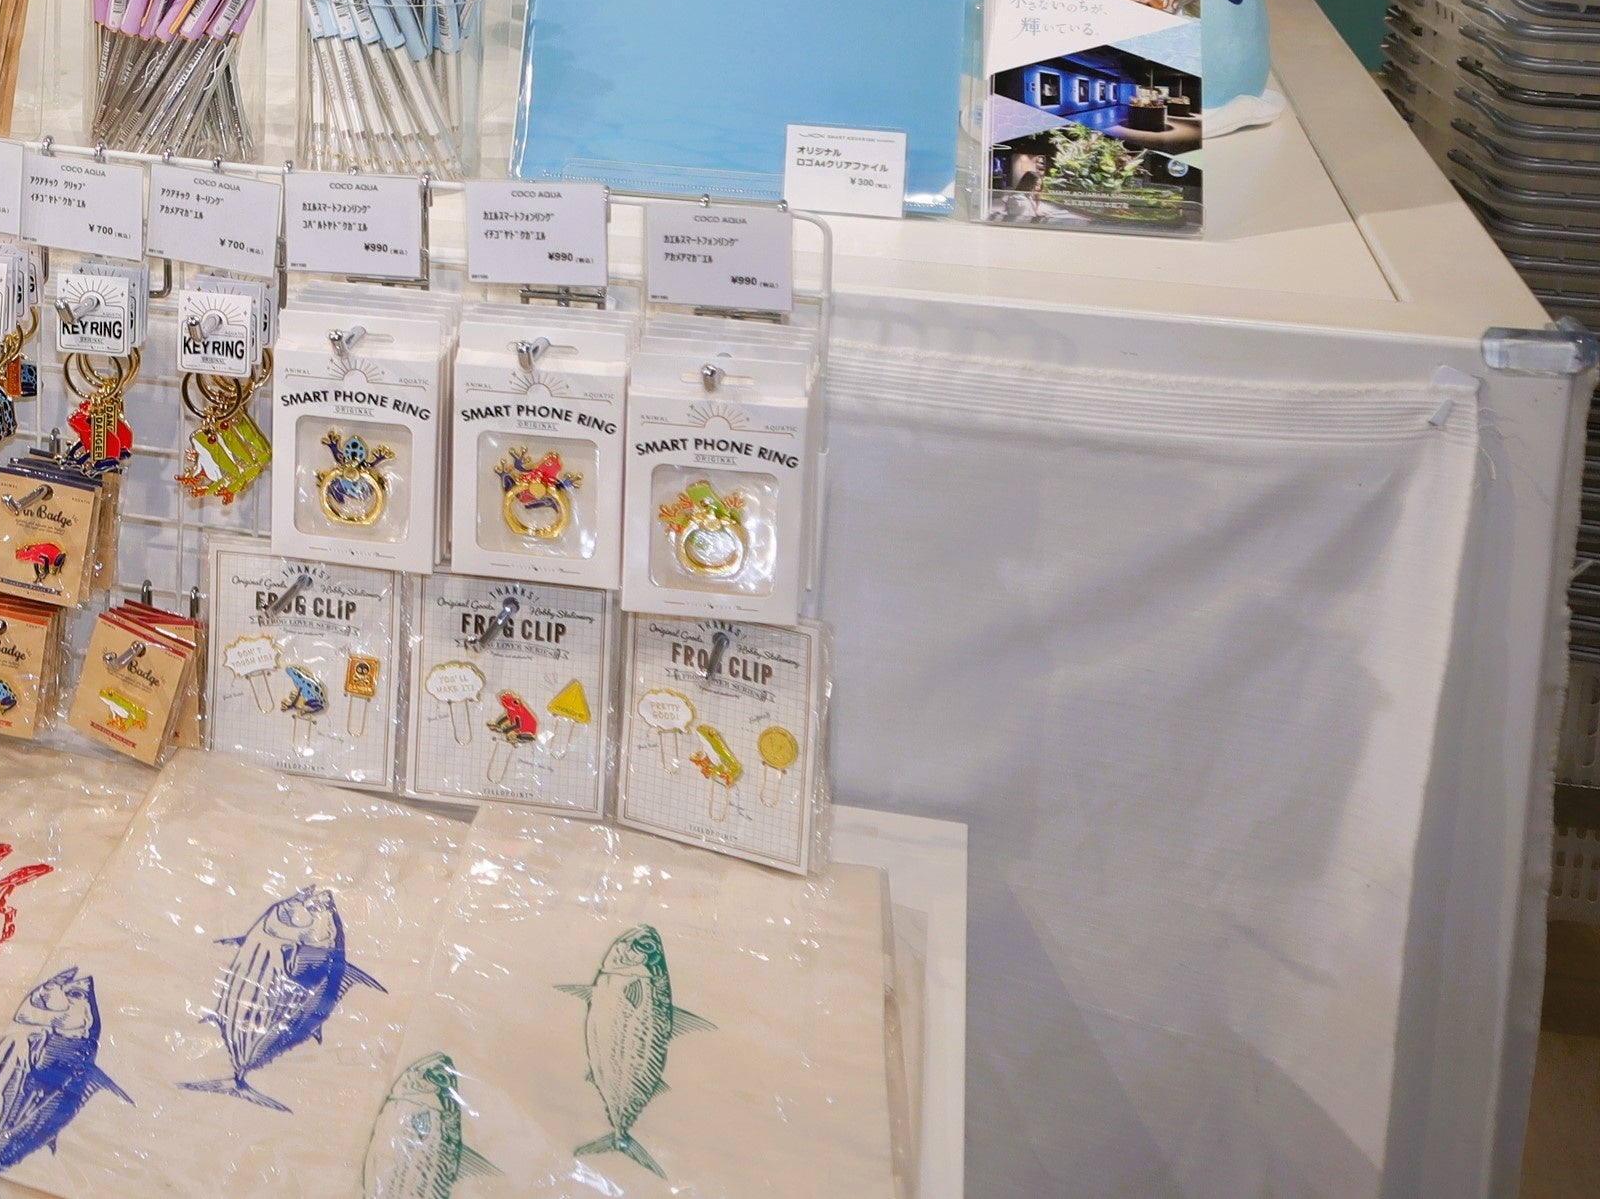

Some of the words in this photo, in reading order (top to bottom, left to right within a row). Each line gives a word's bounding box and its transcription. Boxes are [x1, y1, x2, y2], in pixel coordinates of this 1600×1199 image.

[797, 146, 842, 157] オリジナル
[60, 165, 83, 174] COCO
[84, 168, 106, 177] AQUA
[796, 158, 889, 173] ロゴA4クリアファイル
[193, 177, 217, 188] COCO
[218, 182, 241, 192] AQUA
[329, 182, 353, 190] COCO
[354, 184, 378, 192] AQUA
[849, 177, 874, 187] ¥300
[511, 190, 536, 198] COCO
[538, 191, 563, 199] AQUA
[693, 215, 720, 223] COCO
[88, 223, 113, 235] ¥700
[219, 237, 245, 251] ¥700
[364, 242, 388, 253] ¥990
[547, 251, 574, 262] ¥990
[731, 275, 758, 286] ¥990
[280, 390, 329, 407] SMART
[334, 390, 389, 408] PHONE
[391, 399, 432, 421] RING
[335, 406, 374, 416] ORIGINAL
[460, 404, 512, 422] SMART
[516, 404, 574, 422] PHONE
[577, 413, 618, 435] RING
[517, 420, 557, 430] ORIGINAL
[95, 415, 103, 459] DANGER
[635, 438, 688, 456] SMART
[693, 438, 754, 457] PHONE
[757, 446, 799, 469] RING
[695, 454, 737, 464] ORIGINAL
[36, 504, 73, 527] Badge
[231, 575, 263, 588] Original
[437, 596, 469, 609] Original
[312, 597, 358, 621] CLIP
[520, 619, 567, 644] CLIP
[649, 623, 680, 639] Original
[126, 659, 161, 687] Badge
[729, 656, 774, 685] CLIP
[650, 701, 680, 711] PRETTY
[652, 711, 680, 721] GOOD!
